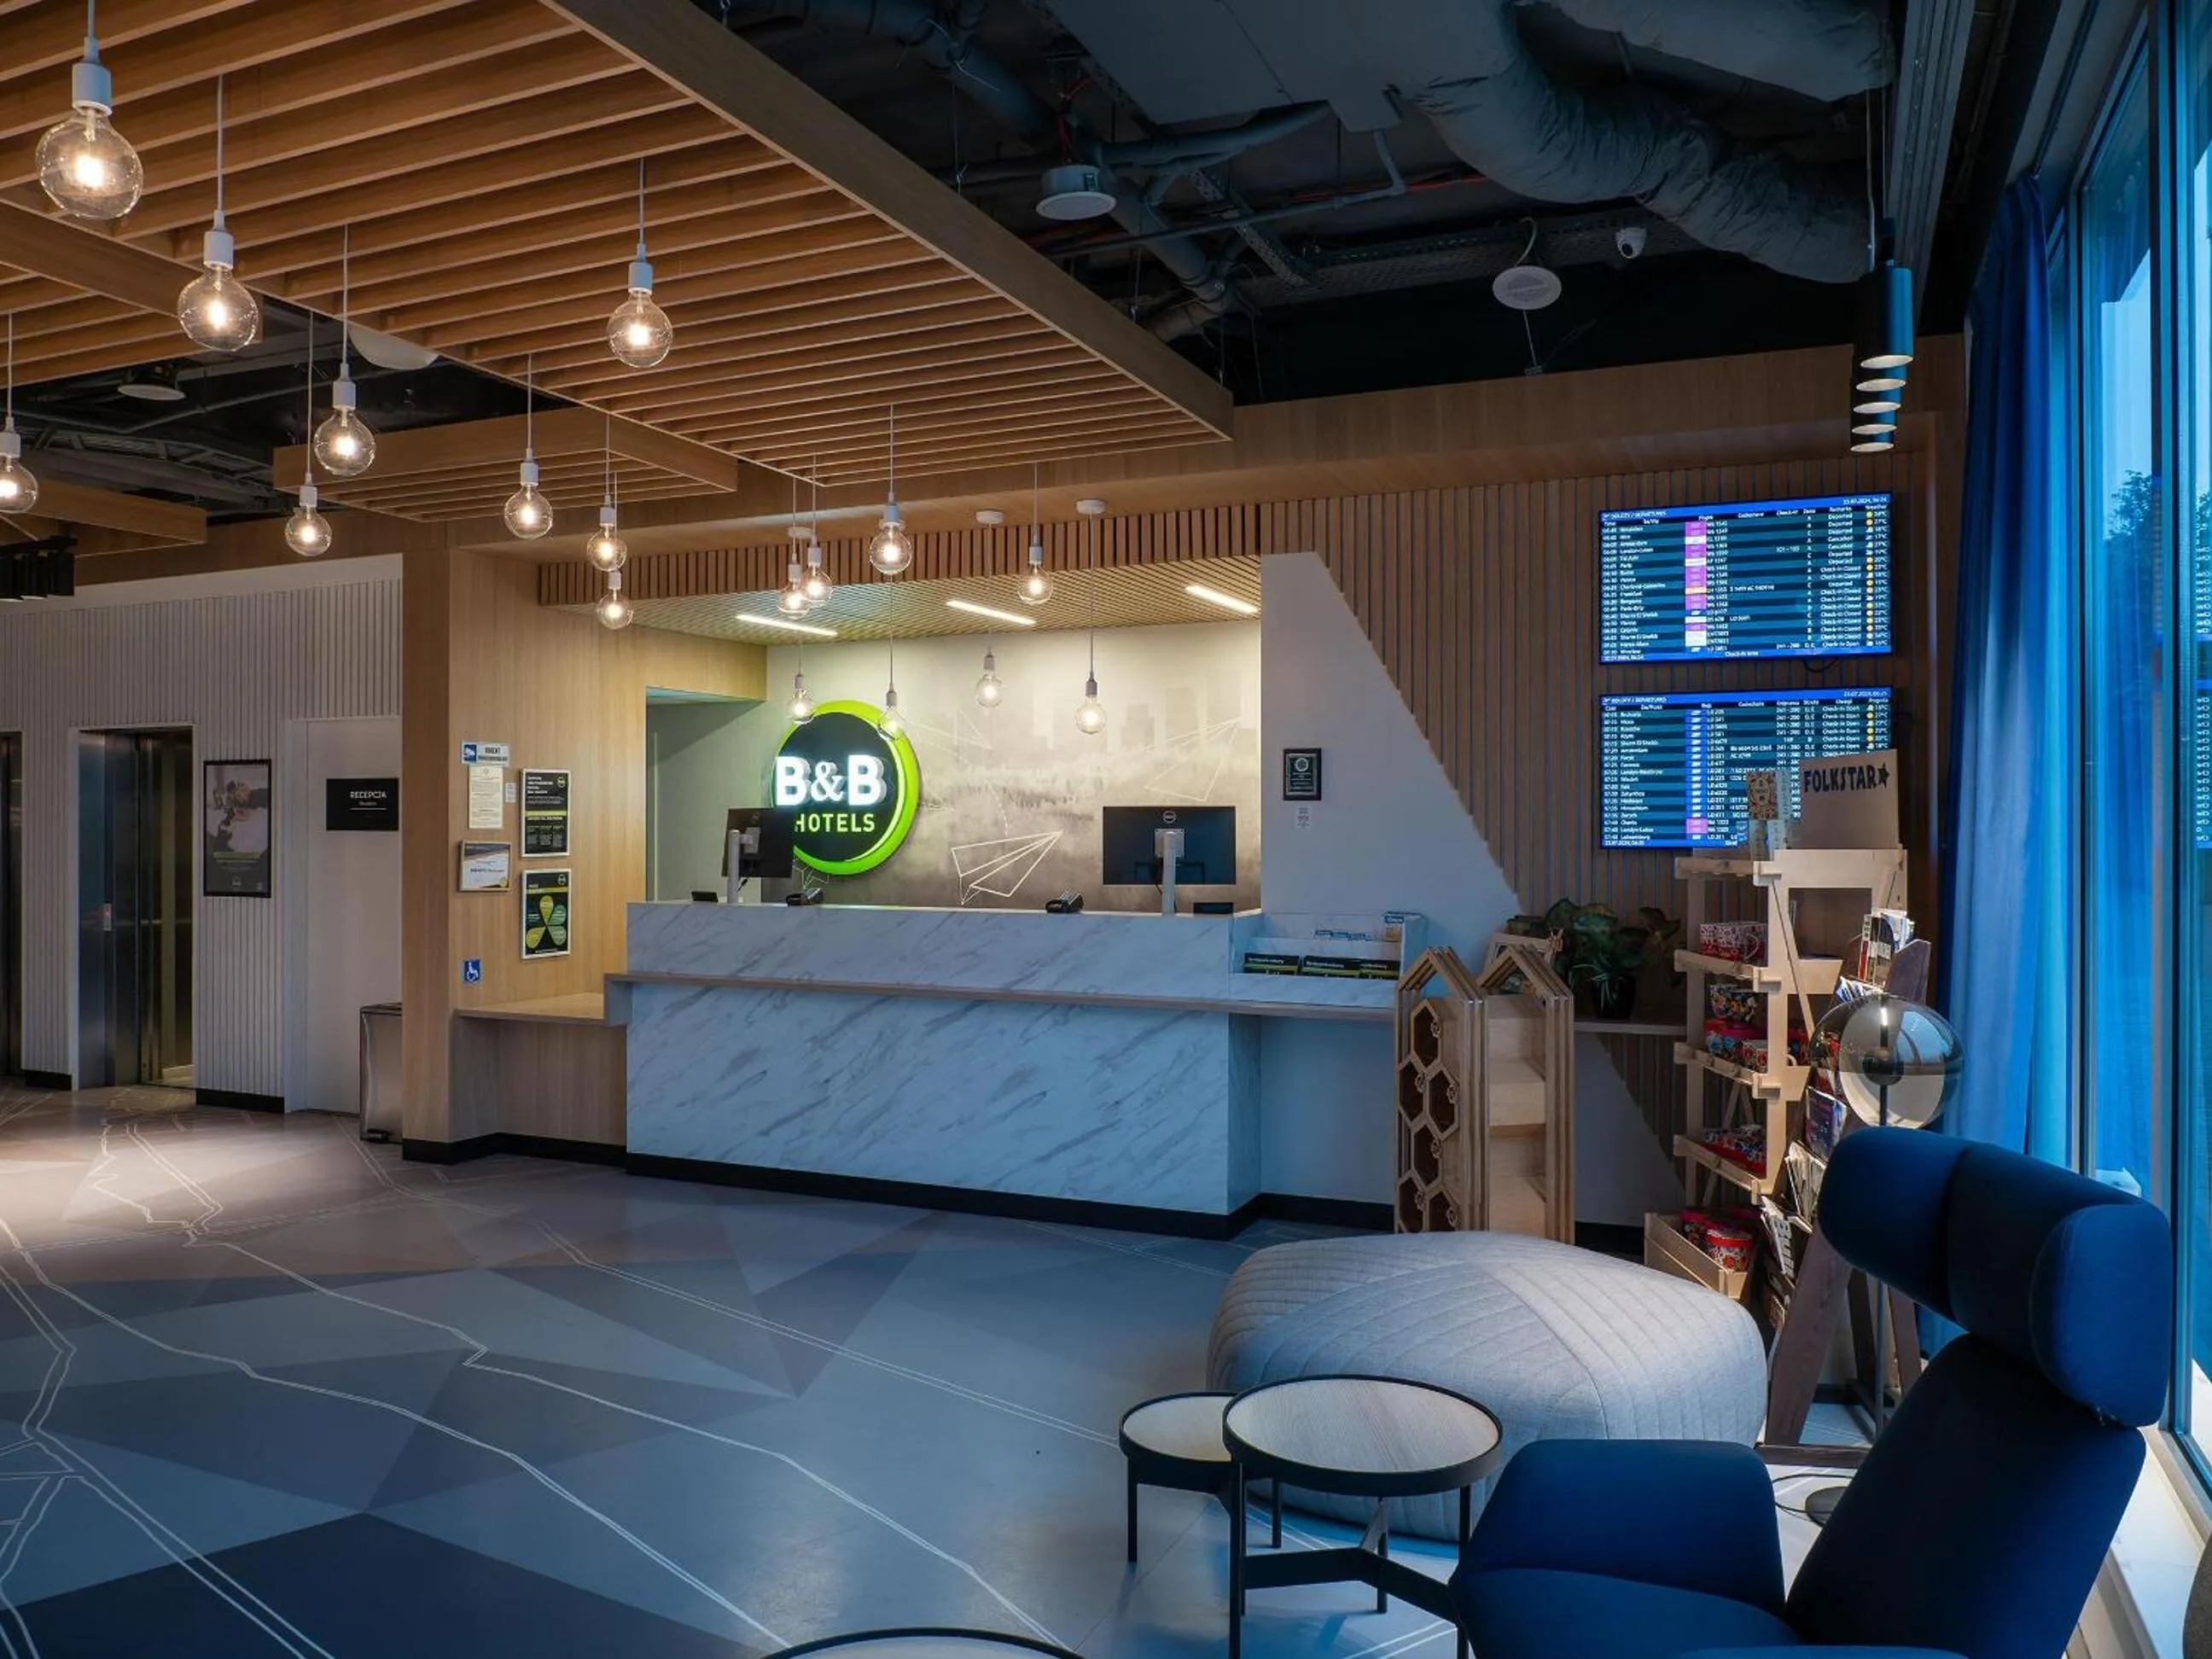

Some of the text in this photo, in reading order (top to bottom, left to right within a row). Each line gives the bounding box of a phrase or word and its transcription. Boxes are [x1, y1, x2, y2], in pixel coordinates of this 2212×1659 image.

[775, 754, 887, 806] B&B
[1803, 765, 1877, 793] FOLKSTAR
[795, 812, 876, 833] HOTELS
